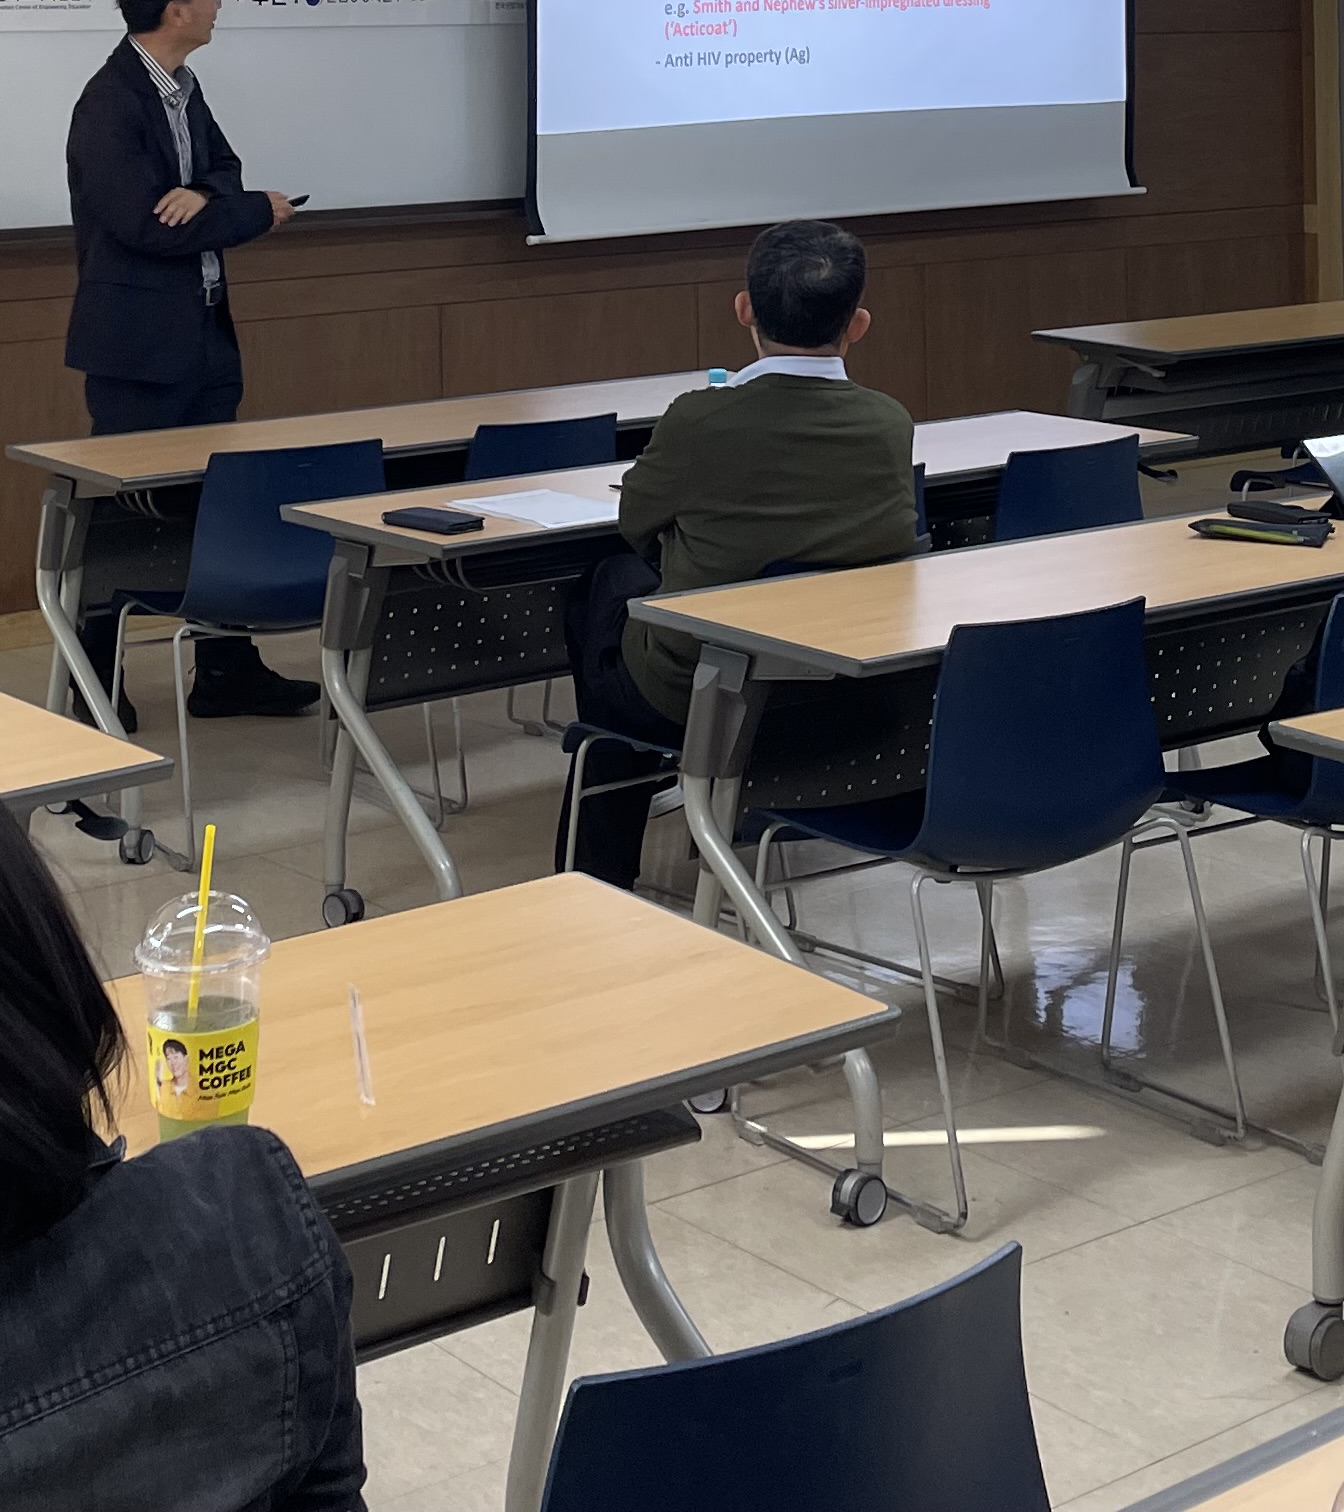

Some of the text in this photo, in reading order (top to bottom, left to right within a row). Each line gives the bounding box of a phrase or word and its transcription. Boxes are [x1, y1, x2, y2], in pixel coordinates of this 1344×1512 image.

[664, 2, 690, 18] e.g.
[664, 52, 694, 68] Anti
[697, 51, 722, 66] HIV
[725, 49, 782, 68] property
[785, 46, 810, 64] (Ag)
[199, 1040, 246, 1061] MEGA
[199, 1058, 238, 1076] MGC
[198, 1065, 252, 1091] COFFEE
